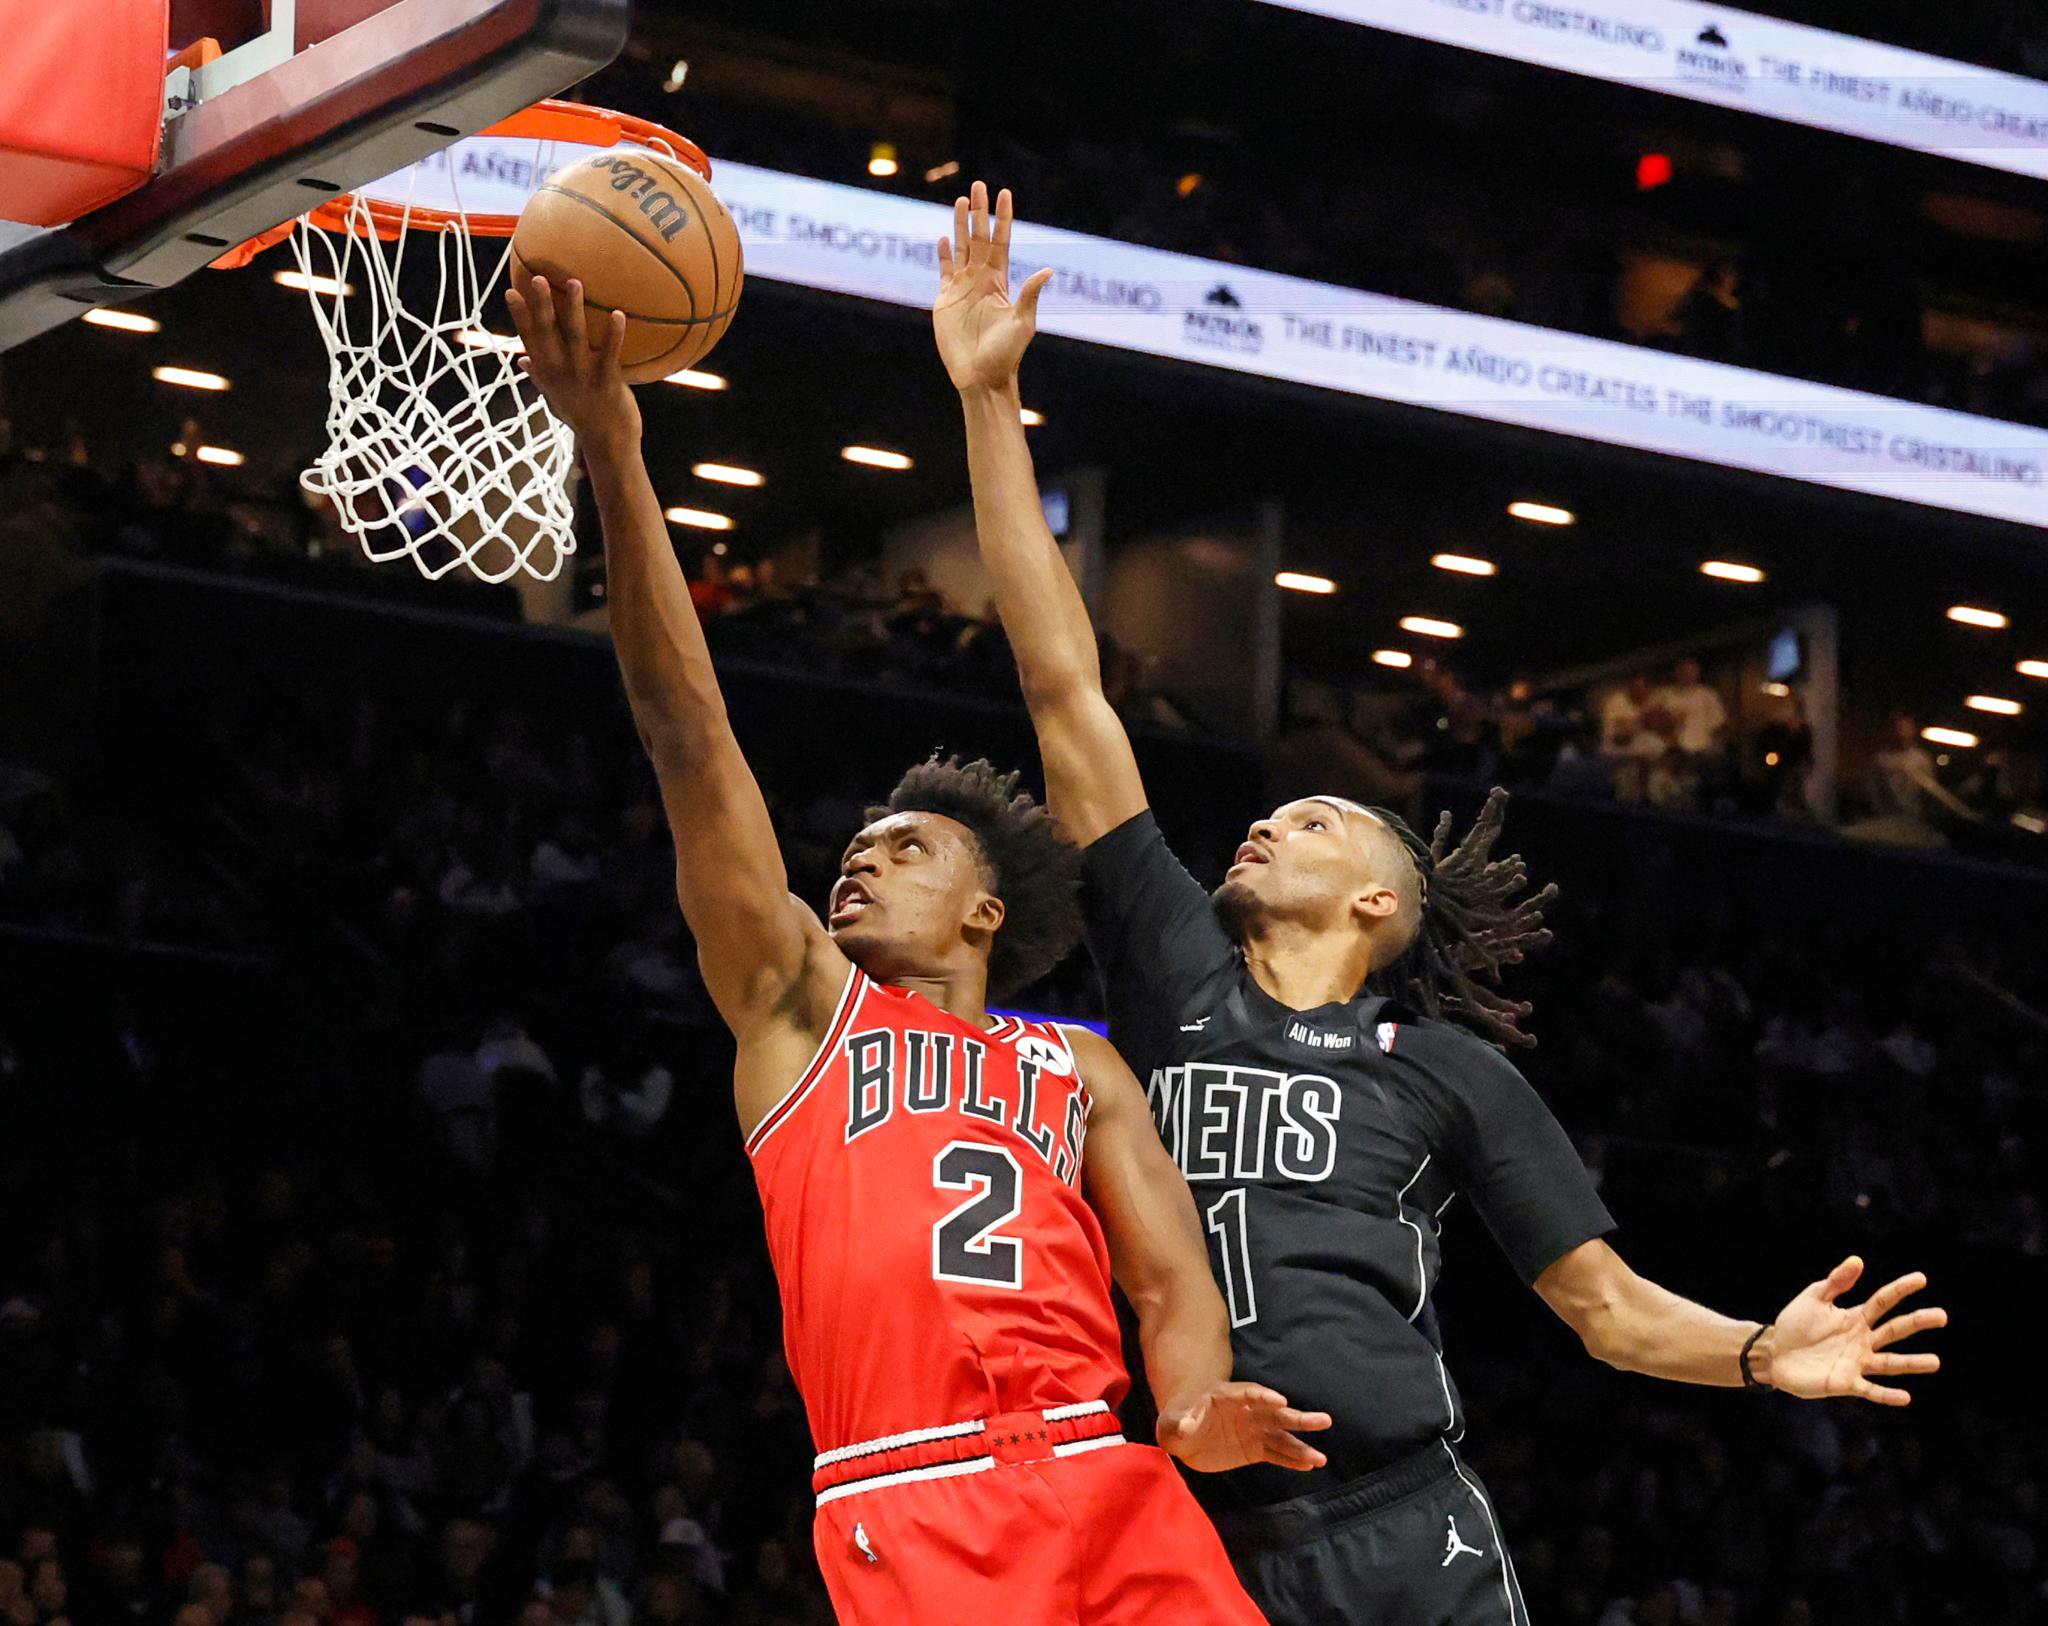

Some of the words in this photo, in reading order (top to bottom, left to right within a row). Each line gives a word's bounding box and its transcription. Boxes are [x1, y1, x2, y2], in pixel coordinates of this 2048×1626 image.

[1760, 56, 1801, 84] THE
[1811, 69, 1891, 105] FINEST
[1281, 312, 1332, 347] THE
[1342, 324, 1435, 367] FINEST
[1445, 345, 1533, 386] AÑEJO
[1537, 364, 1657, 412] CREATES
[1664, 390, 1712, 424] THE
[1721, 401, 1882, 456] SMOOTHEST
[1288, 1022, 1306, 1042] All
[1307, 1030, 1321, 1047] In
[1323, 1032, 1352, 1049] Won
[932, 1141, 1023, 1290] 2
[1208, 1188, 1258, 1329] 1
